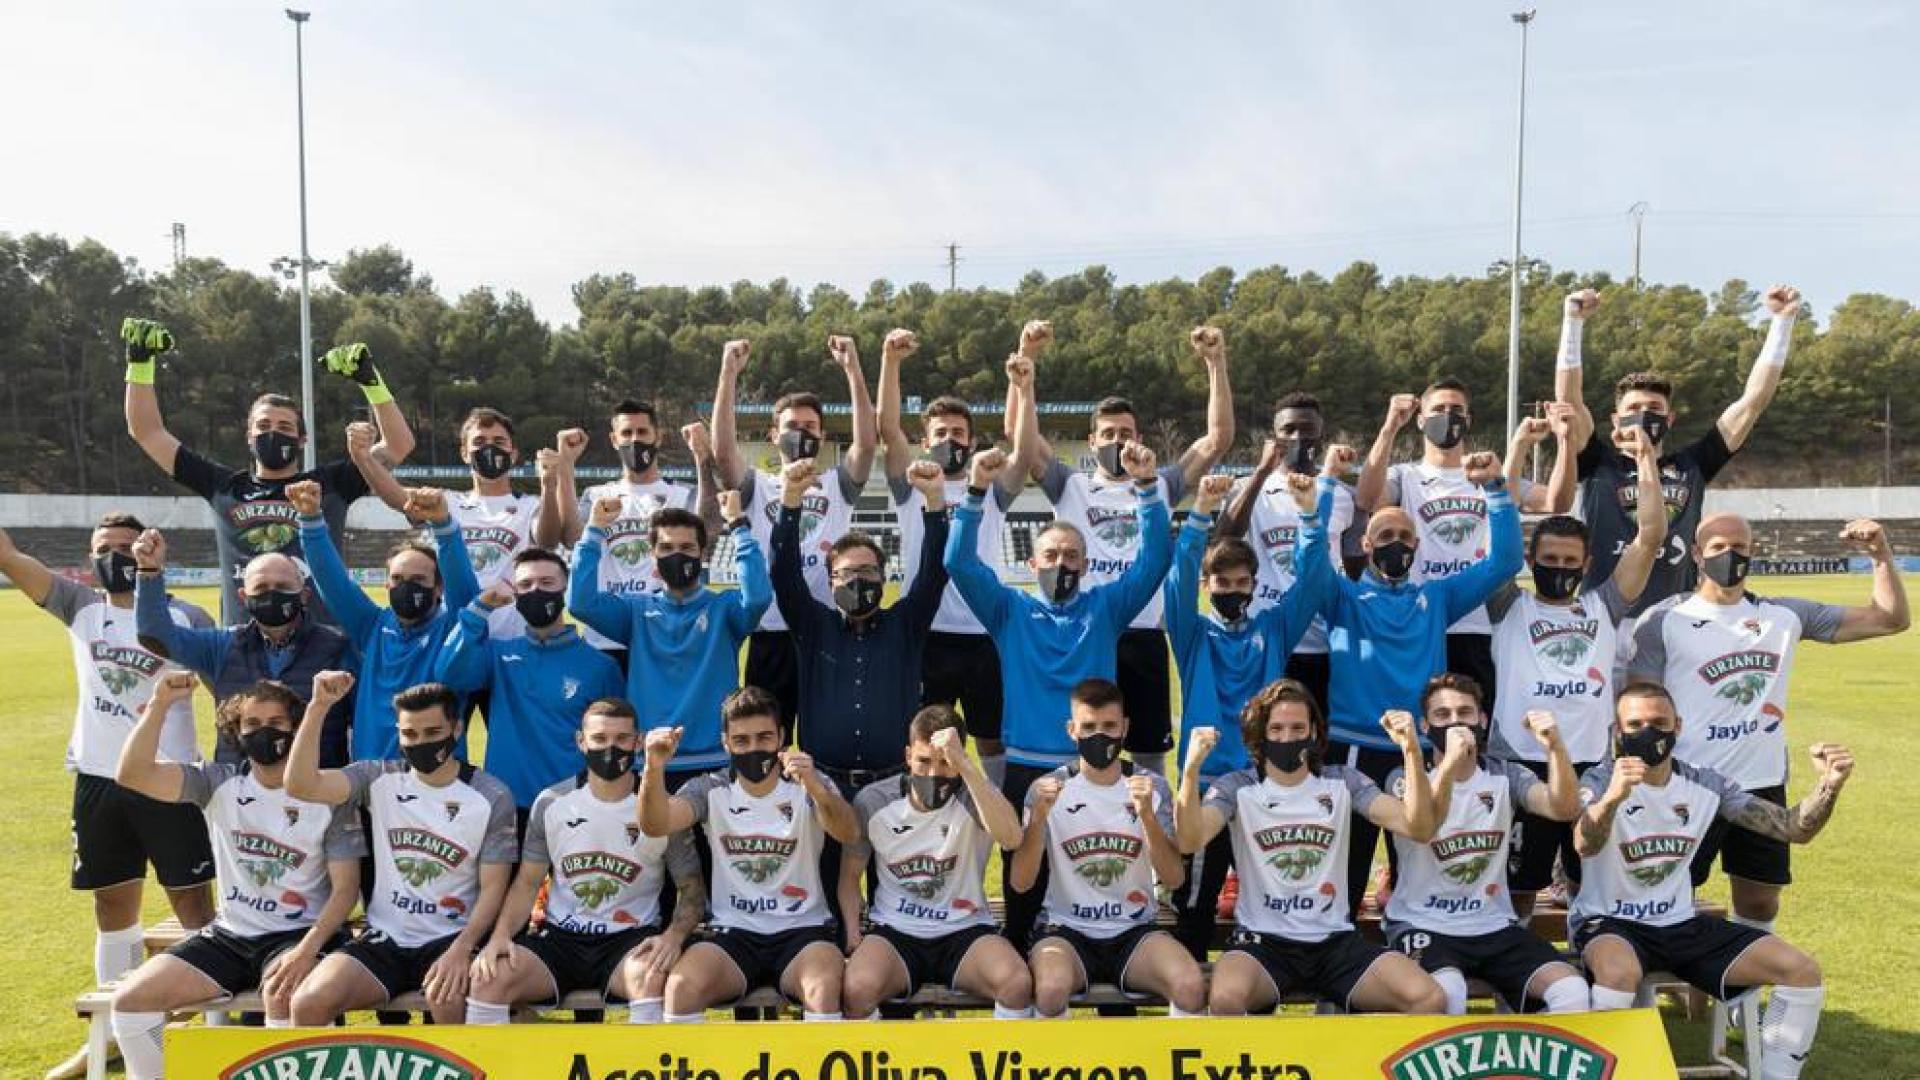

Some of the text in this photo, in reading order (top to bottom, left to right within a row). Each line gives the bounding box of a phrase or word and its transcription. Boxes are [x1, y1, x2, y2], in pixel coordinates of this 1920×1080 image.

[235, 504, 297, 521] URZANT
[1424, 499, 1483, 516] URZANTE
[1705, 654, 1773, 678] URZANTE
[1532, 680, 1588, 698] Jaylo
[1705, 719, 1759, 741] Jaylo
[727, 838, 792, 854] URZANTE
[1066, 836, 1135, 856] URZANTE
[1260, 827, 1334, 845] URZANTE
[391, 831, 461, 862] URZANTE
[563, 856, 633, 878] URZANTE
[730, 894, 779, 914] Jaylo
[896, 898, 950, 920] Jaylo
[1071, 902, 1122, 920] Jaylo
[1263, 894, 1314, 914] Jaylo
[1424, 895, 1482, 914] Jaylo
[1612, 899, 1670, 919] Jaylo
[1402, 932, 1431, 956] 18
[566, 1048, 1312, 1080] Ait d Oli Vir Etr
[1403, 1033, 1593, 1080] URZANTE
